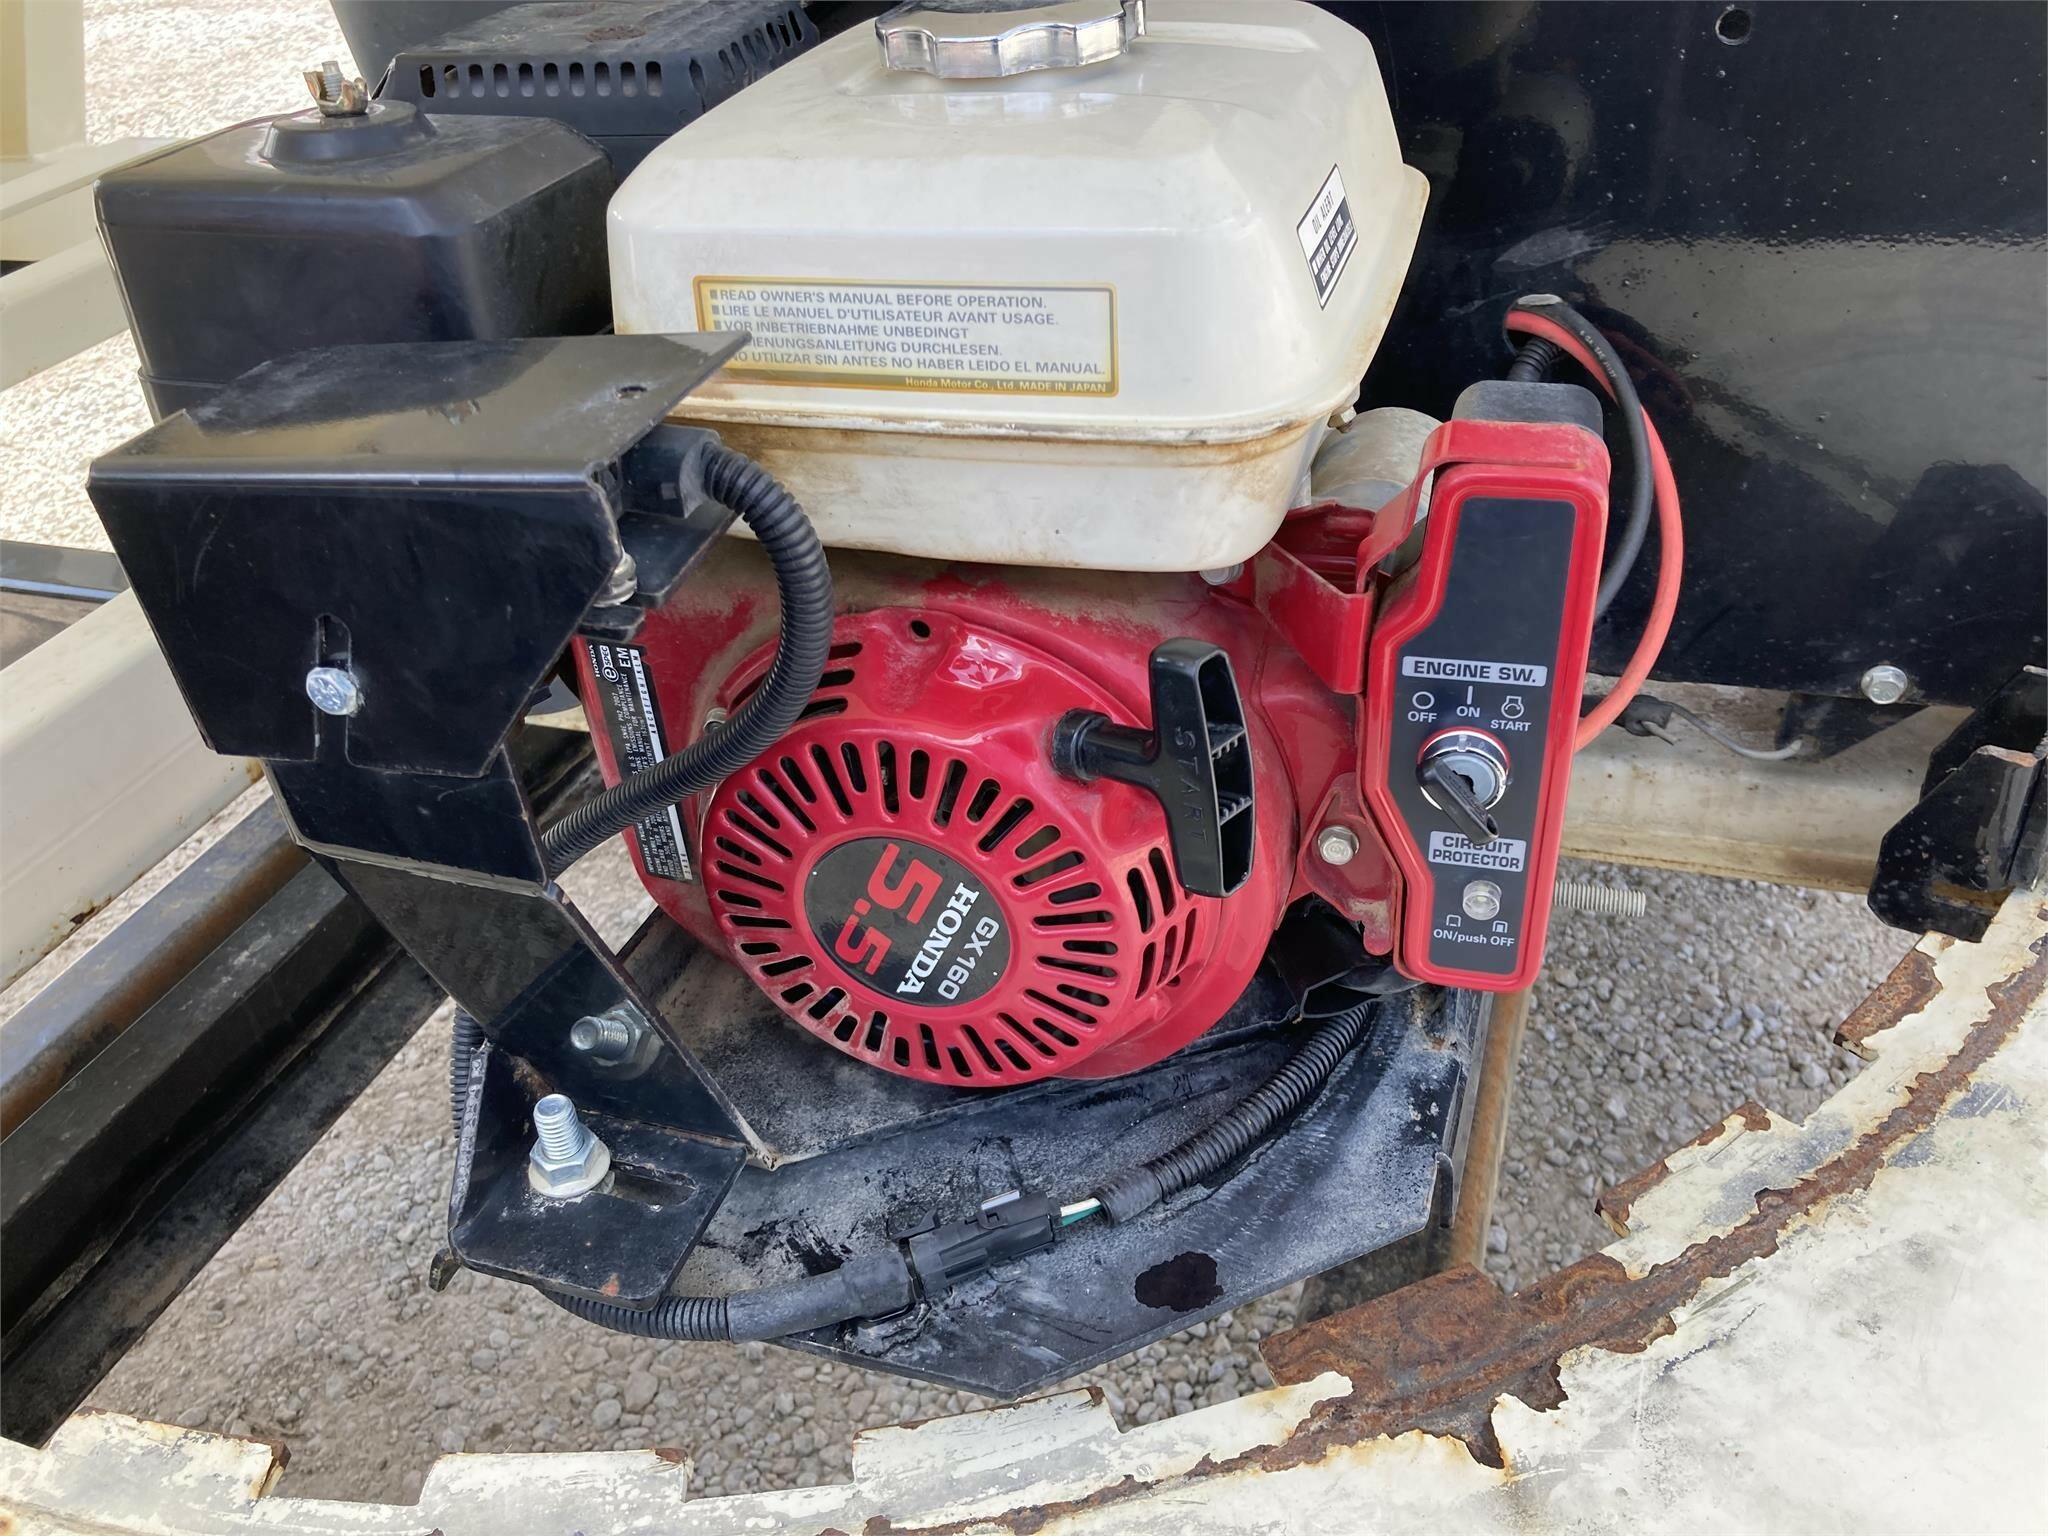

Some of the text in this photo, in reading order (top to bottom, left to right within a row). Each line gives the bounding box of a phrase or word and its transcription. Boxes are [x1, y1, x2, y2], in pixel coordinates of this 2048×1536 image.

[720, 290, 1047, 308] READ OWNER'S MANUAL BEFORE OPERATION.
[722, 305, 1058, 325] LIRE LE MANUEL D'UTILISATEUR AVANT USAGE.
[724, 320, 969, 339] VOR INBETRIEBNAHME UNBEDINGT
[752, 336, 1002, 356] IENUNGSANLEITUNG DURCHLESEN.
[752, 352, 811, 364] UTILIZAR
[815, 354, 838, 366] SIN
[842, 355, 888, 368] ANTES
[892, 357, 912, 369] NO
[917, 358, 964, 371] HABER
[969, 360, 1010, 372] LEIDO
[1015, 361, 1031, 373] EL
[1036, 361, 1105, 375] MANUAL.
[906, 376, 938, 388] Honda
[941, 378, 972, 389] Motor
[1020, 381, 1051, 392] MADE
[1055, 382, 1067, 392] IN
[1070, 383, 1106, 393] JAPAN
[589, 645, 600, 677] HONDA
[617, 647, 631, 668] EM
[1413, 660, 1536, 683] ENGINE SW.
[1407, 711, 1437, 723] OFF
[1456, 706, 1480, 718] ON
[1490, 719, 1531, 731] START
[1433, 849, 1520, 869] PROTECTOR
[897, 882, 980, 994] HONDA
[1433, 929, 1515, 947] ON/push OFF
